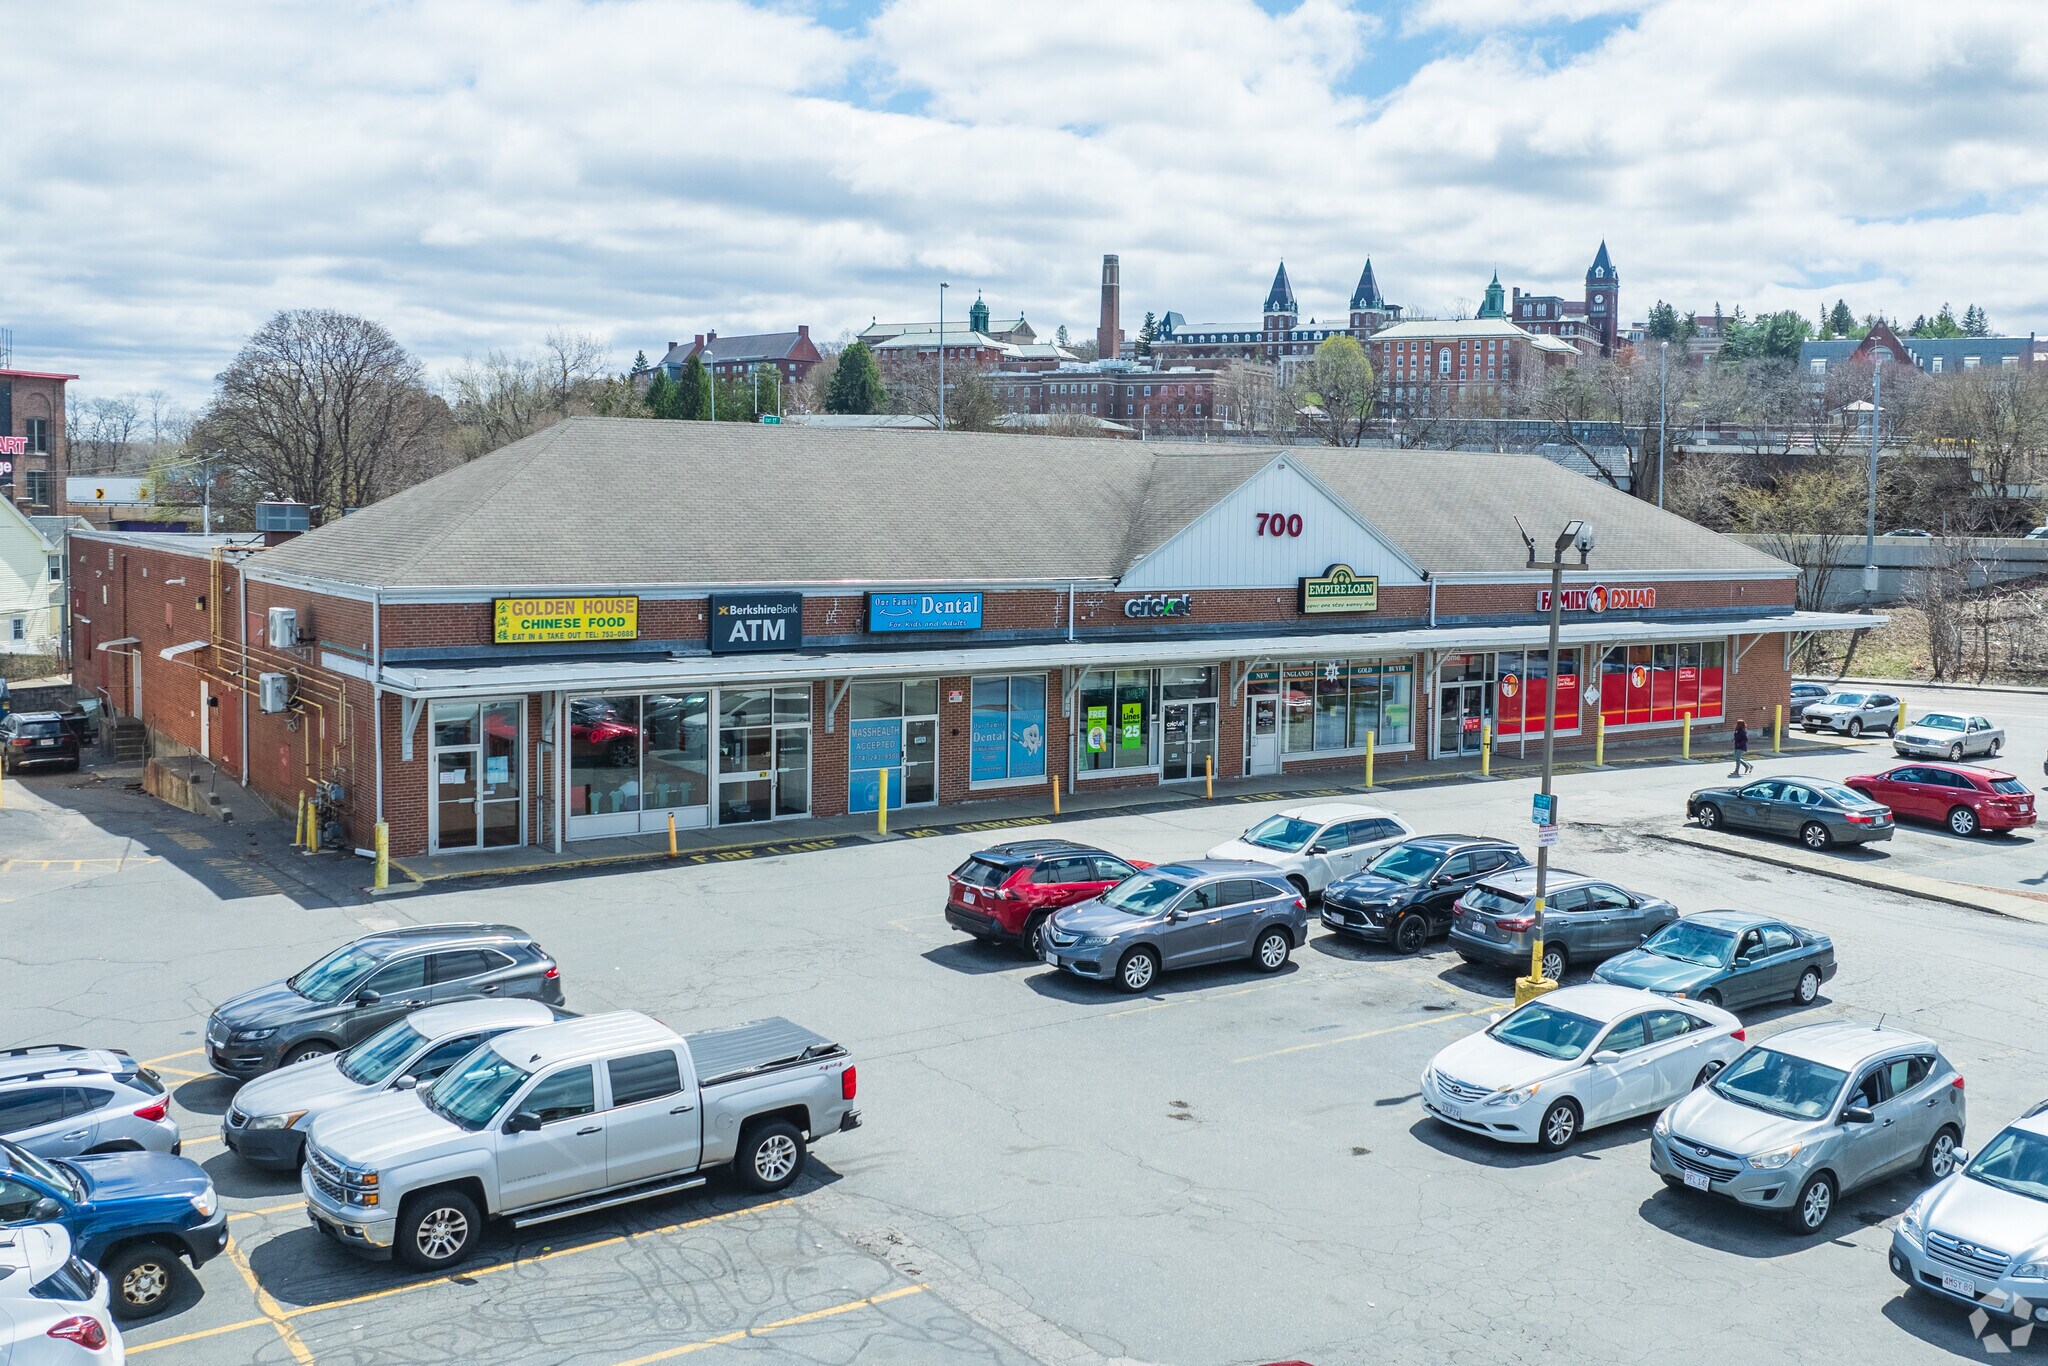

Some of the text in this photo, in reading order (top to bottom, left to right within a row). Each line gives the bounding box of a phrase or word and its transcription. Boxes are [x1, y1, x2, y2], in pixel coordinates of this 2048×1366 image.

[1256, 513, 1303, 537] 700
[1309, 583, 1373, 595] EMPIRE LOAN
[875, 597, 917, 606] Our Family
[921, 596, 978, 614] Dental
[1610, 588, 1656, 609] DOLLAR
[512, 599, 634, 616] GOLDEN HOUSE
[730, 603, 798, 615] BerkshireBank
[1124, 594, 1191, 617] cricket
[521, 617, 626, 630] CHINESE FOOD
[905, 620, 921, 628] Kids
[567, 631, 581, 639] OUT
[601, 630, 634, 638] 753-0888
[728, 619, 785, 642] ATM
[1283, 670, 1314, 678] ENGLAND'S
[1089, 709, 1106, 718] FREE
[852, 725, 900, 738] MASSHEALTH
[973, 731, 1006, 742] Dental
[856, 740, 896, 750] ACCEPTED
[905, 817, 1052, 839] NO PARKING
[690, 840, 838, 863] FIRE LANE
